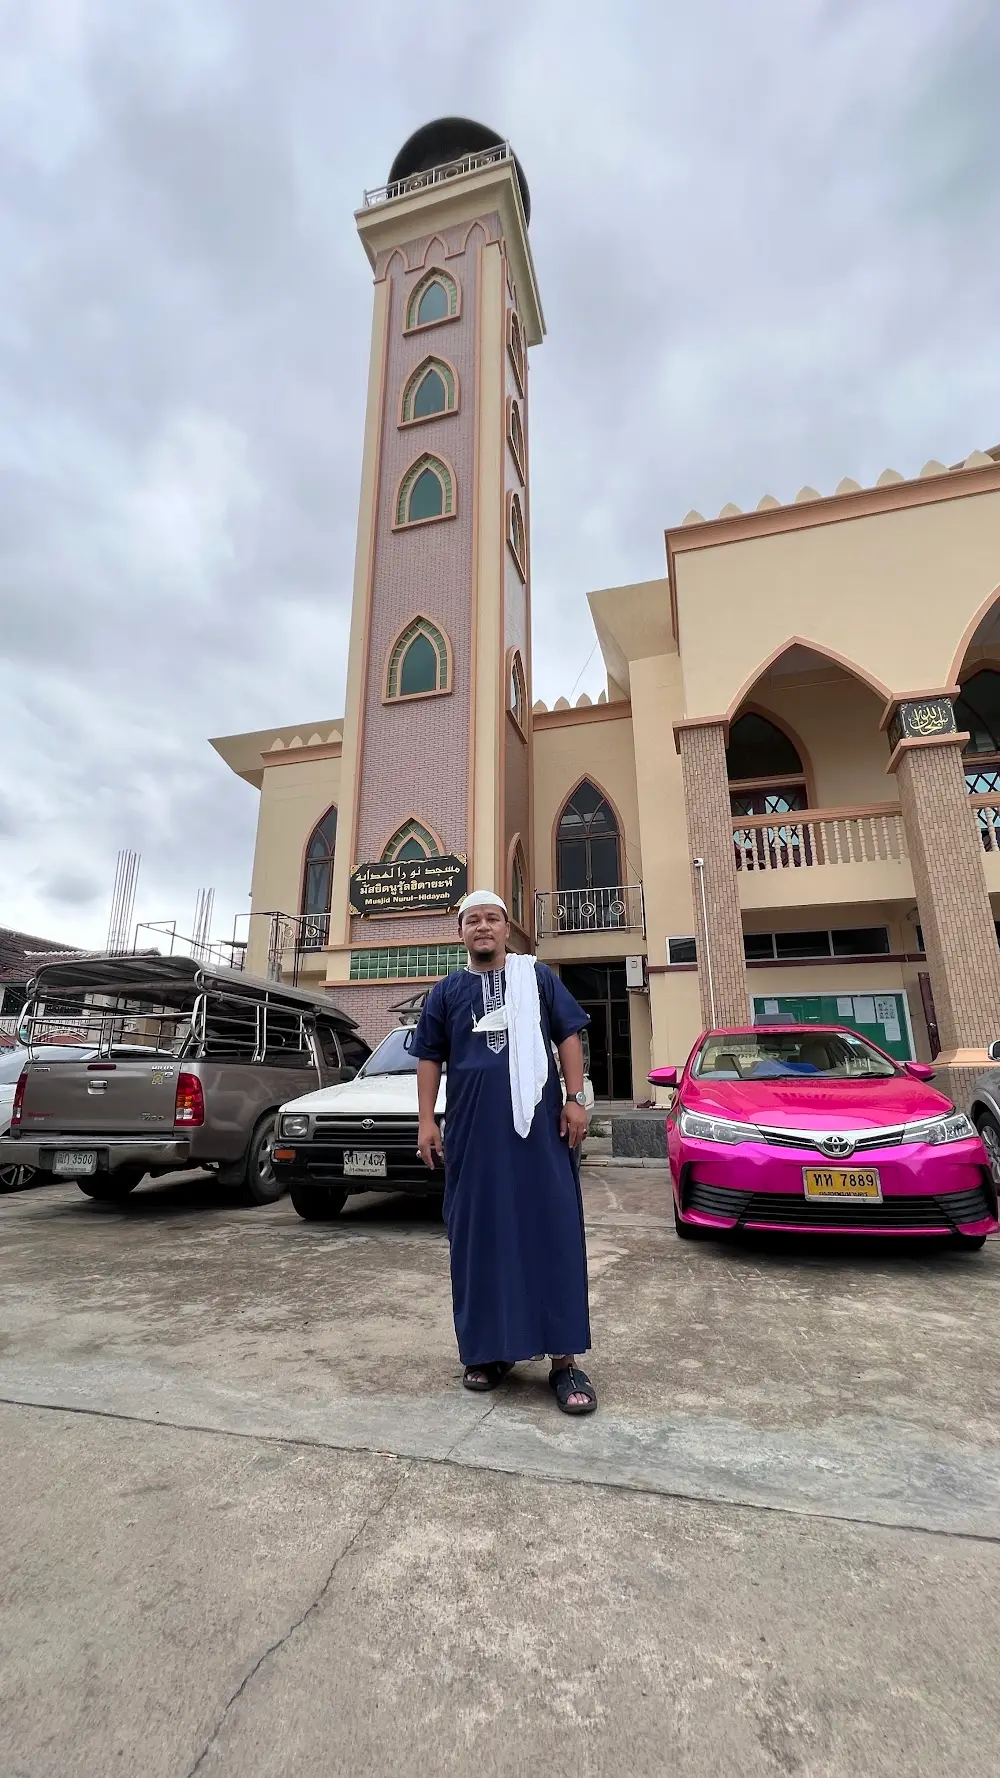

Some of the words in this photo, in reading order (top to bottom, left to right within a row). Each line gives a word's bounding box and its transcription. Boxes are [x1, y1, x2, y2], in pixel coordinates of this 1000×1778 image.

[425, 864, 461, 877] مسجد
[364, 896, 391, 906] Musjid
[393, 891, 450, 904] Nurul-Hidayah
[72, 1153, 93, 1165] 3500
[839, 1173, 874, 1187] 7889
